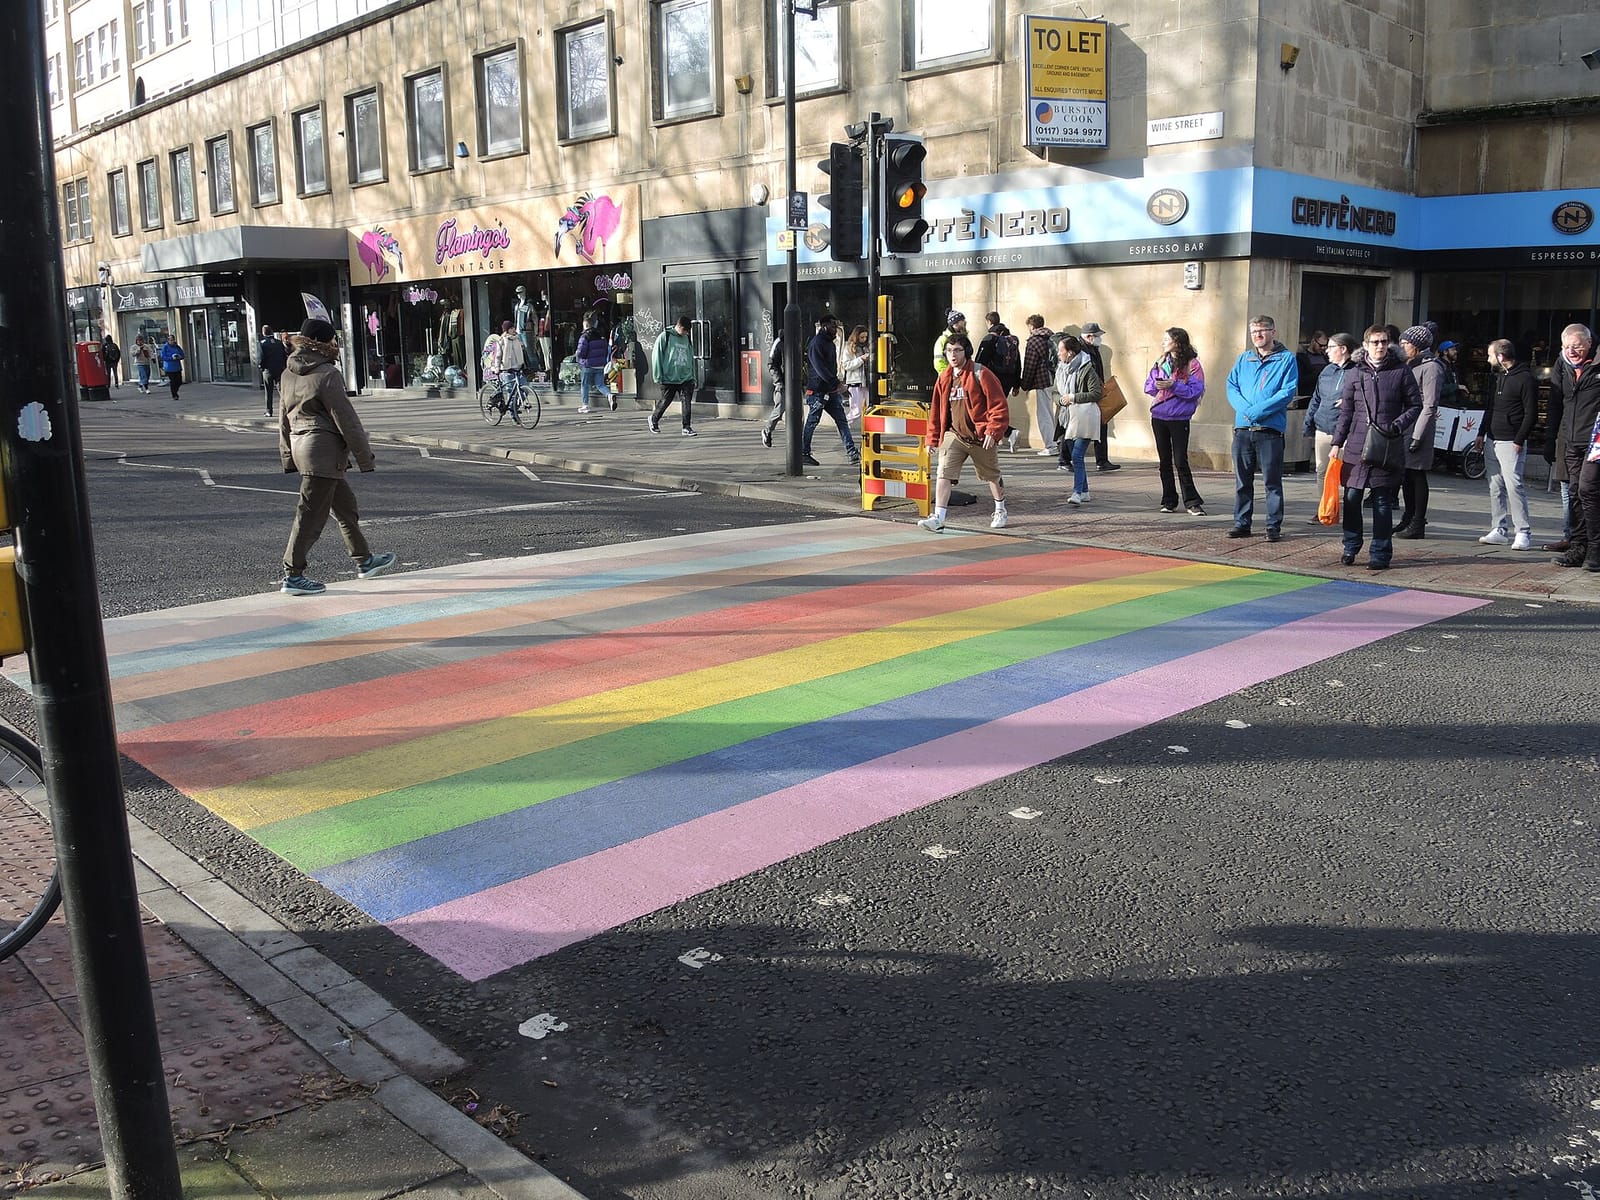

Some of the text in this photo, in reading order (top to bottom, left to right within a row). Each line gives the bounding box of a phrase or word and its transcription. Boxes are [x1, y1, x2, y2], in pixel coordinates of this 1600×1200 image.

[1033, 28, 1101, 54] TO LET
[1054, 105, 1102, 114] BURSTON
[1063, 114, 1093, 123] COOK
[1151, 118, 1204, 132] WINE STREET
[1035, 126, 1102, 136] (0117) 934 9977
[1292, 194, 1396, 236] CAFFÈ NERO
[923, 207, 1070, 243] FFÈ NERO
[1129, 242, 1204, 255] ESPRESSO BAR
[1316, 245, 1325, 254] THE
[1326, 246, 1345, 256] ITALIAN
[1346, 248, 1363, 258] COFFEE
[925, 259, 939, 267] THE
[942, 256, 973, 266] ITALIAN
[976, 254, 1007, 264] COFFEE
[1531, 251, 1585, 260] ESPRESSO
[443, 260, 504, 273] VINTAGE
[798, 267, 826, 276] SPRESSO
